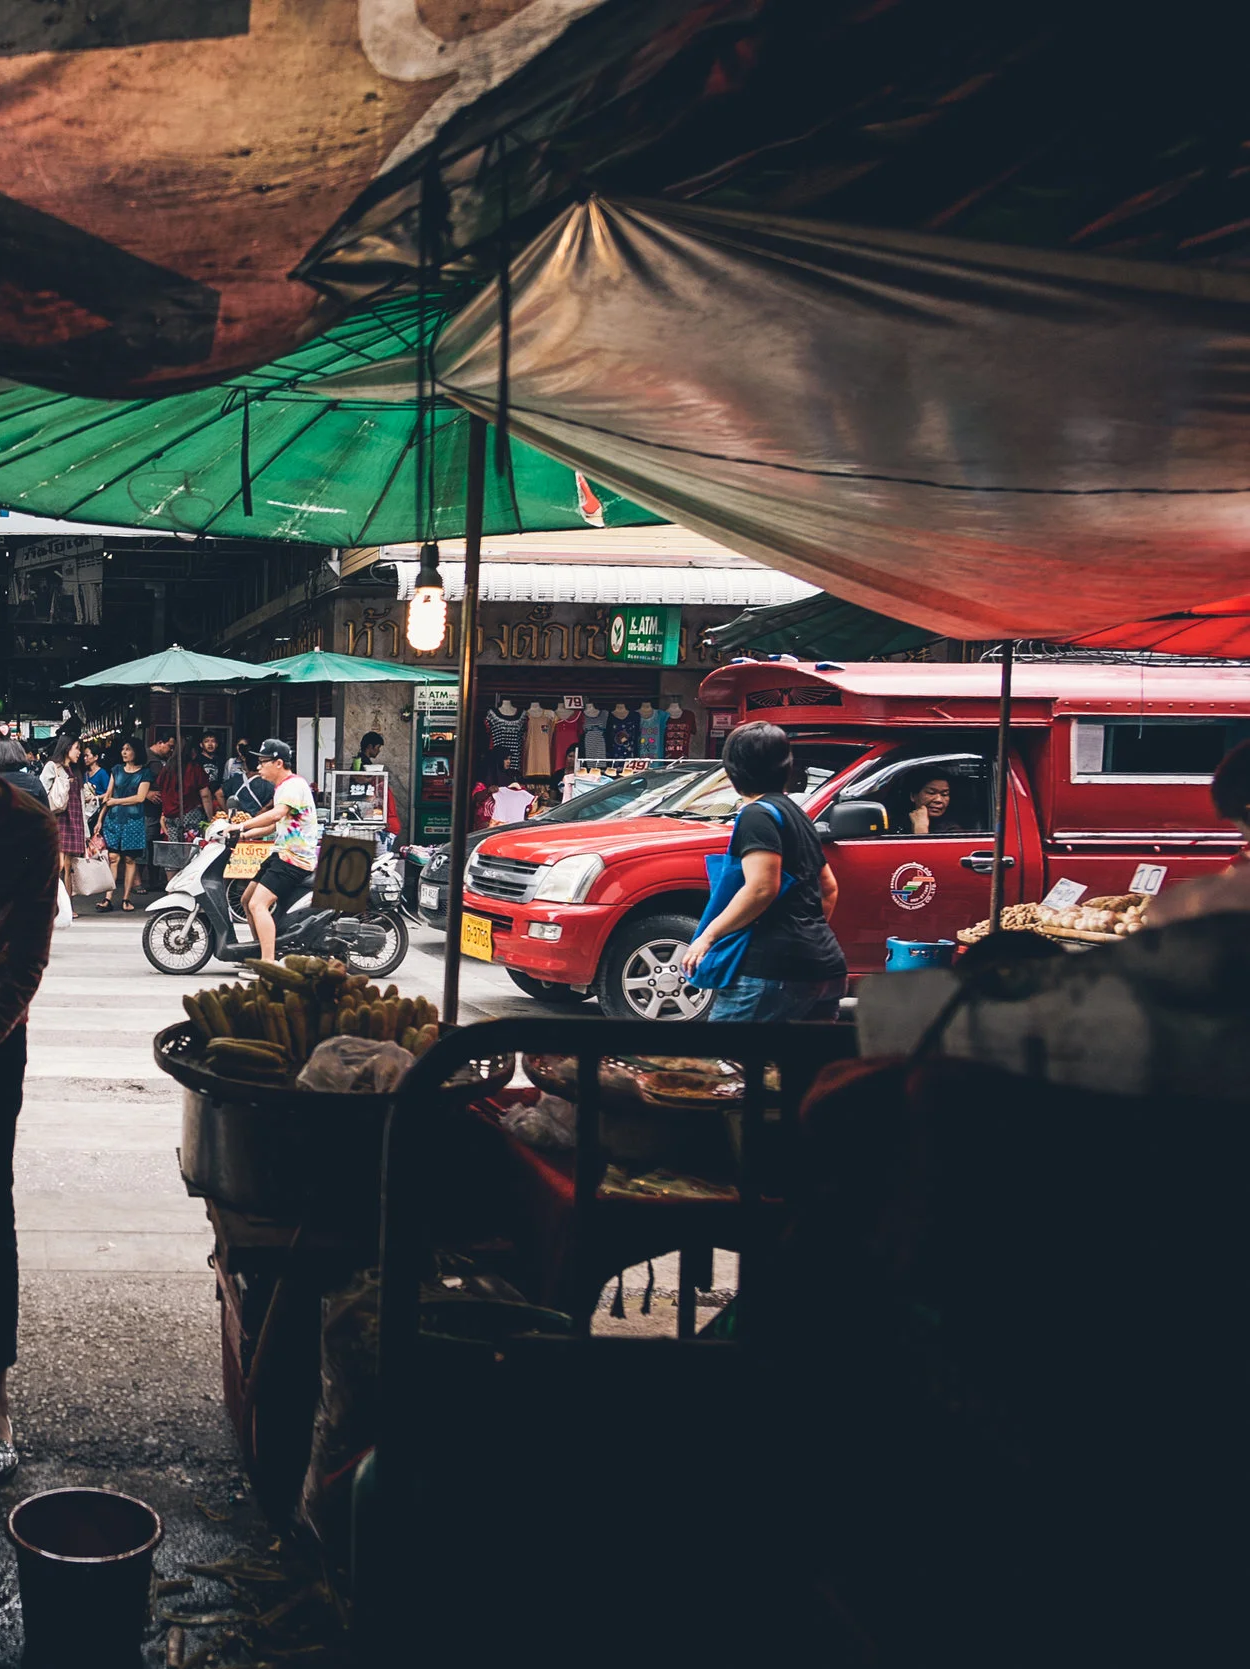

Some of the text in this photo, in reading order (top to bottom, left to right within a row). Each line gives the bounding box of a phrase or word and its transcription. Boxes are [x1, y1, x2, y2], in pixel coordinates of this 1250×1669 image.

[638, 616, 658, 635] ATM
[566, 697, 582, 707] 79
[626, 761, 646, 771] 49
[318, 844, 372, 898] 10
[1131, 868, 1162, 892] 10
